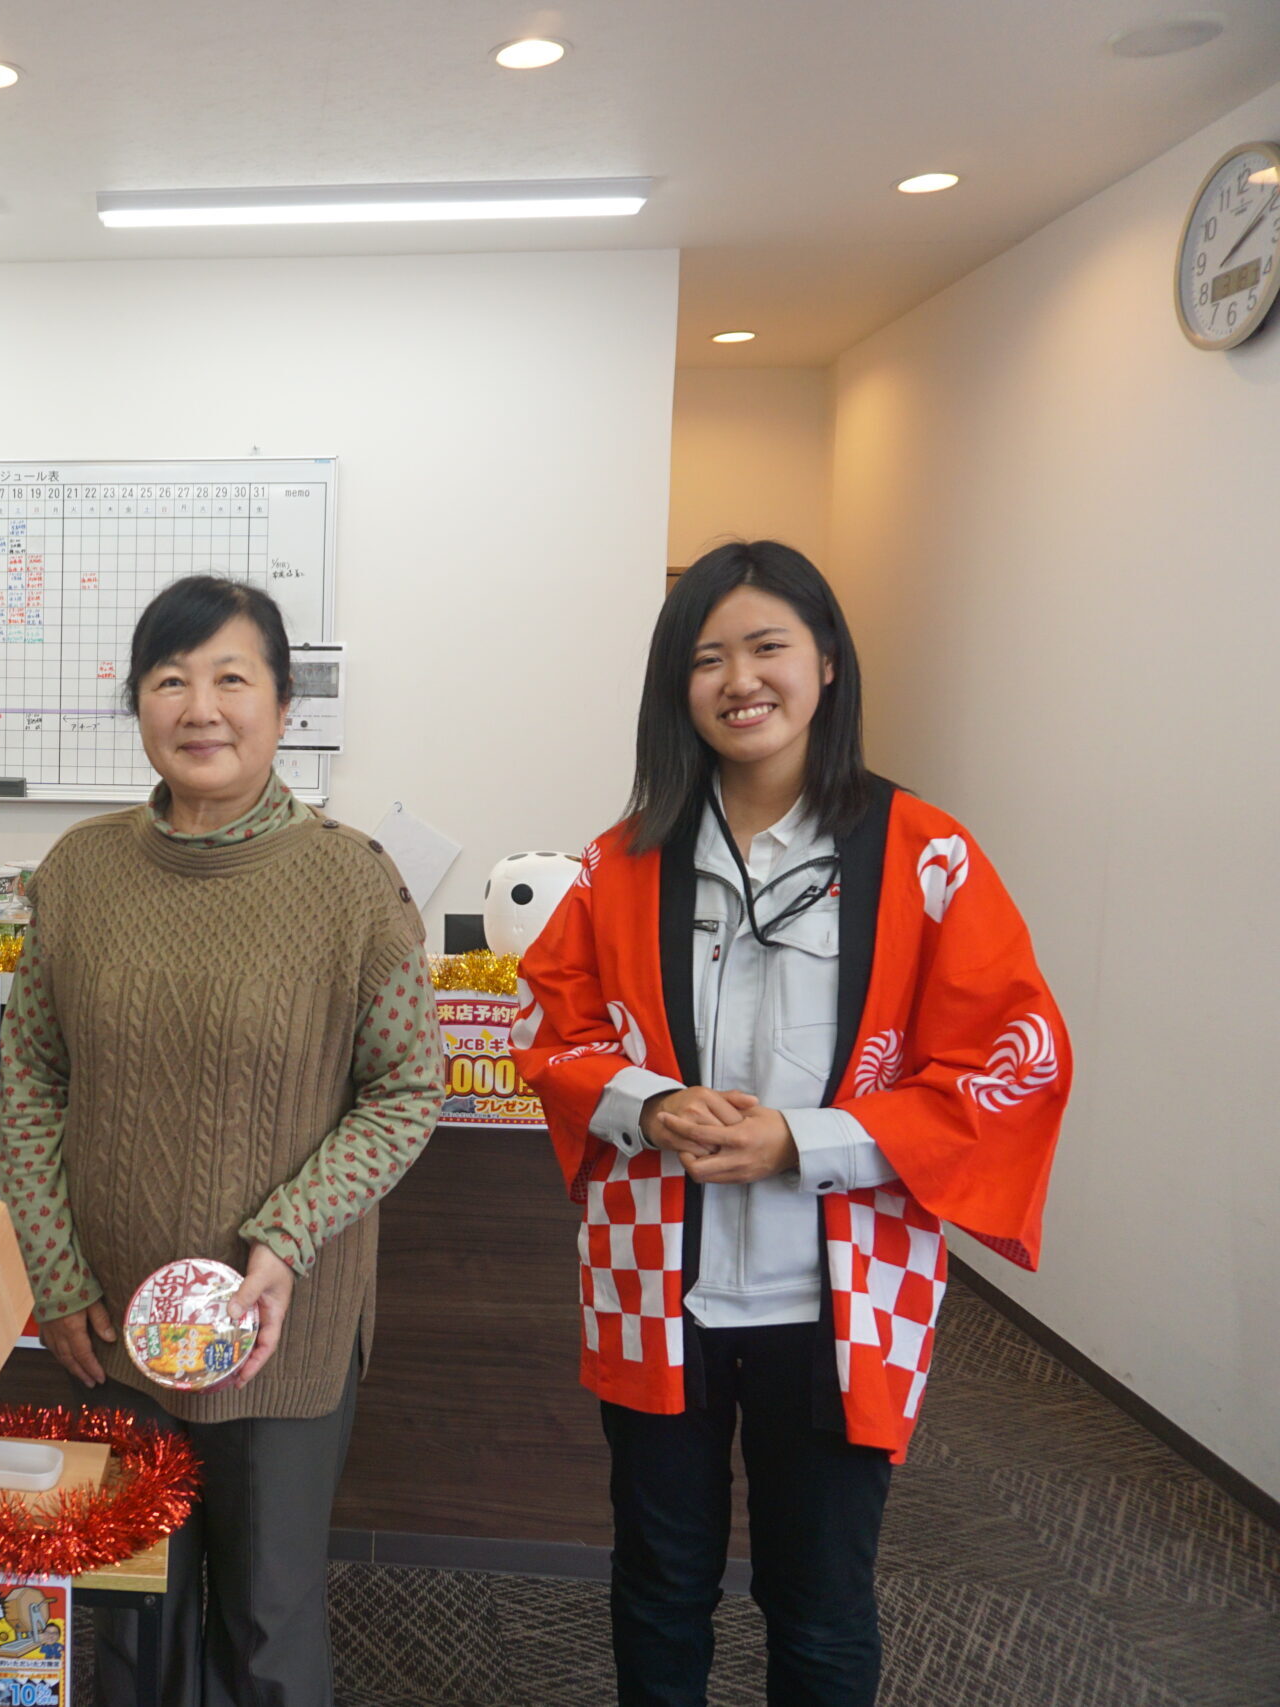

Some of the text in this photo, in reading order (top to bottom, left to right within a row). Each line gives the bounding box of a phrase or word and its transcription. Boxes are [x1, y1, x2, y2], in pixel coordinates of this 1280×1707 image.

[1237, 167, 1251, 194] 12
[1220, 186, 1231, 212] 11
[1202, 216, 1217, 242] 10
[1196, 252, 1207, 276] 9
[1262, 255, 1273, 276] 4
[1199, 283, 1209, 306] 8
[1247, 286, 1258, 311] 5
[1210, 302, 1219, 326] 7
[1227, 301, 1237, 326] 6
[13, 488, 23, 499] 18
[31, 488, 41, 499] 19
[48, 488, 60, 499] 20
[67, 488, 78, 498] 21
[85, 488, 97, 498] 22
[103, 488, 115, 498] 23
[122, 488, 134, 498] 24
[140, 488, 152, 498] 25
[159, 487, 171, 498] 26
[178, 487, 190, 498] 27
[196, 487, 208, 498] 28
[215, 487, 228, 498] 29
[234, 487, 247, 498] 30
[253, 487, 265, 498] 31
[285, 489, 310, 498] memo
[454, 1039, 485, 1051] JCB
[475, 1099, 544, 1113] プレゼント
